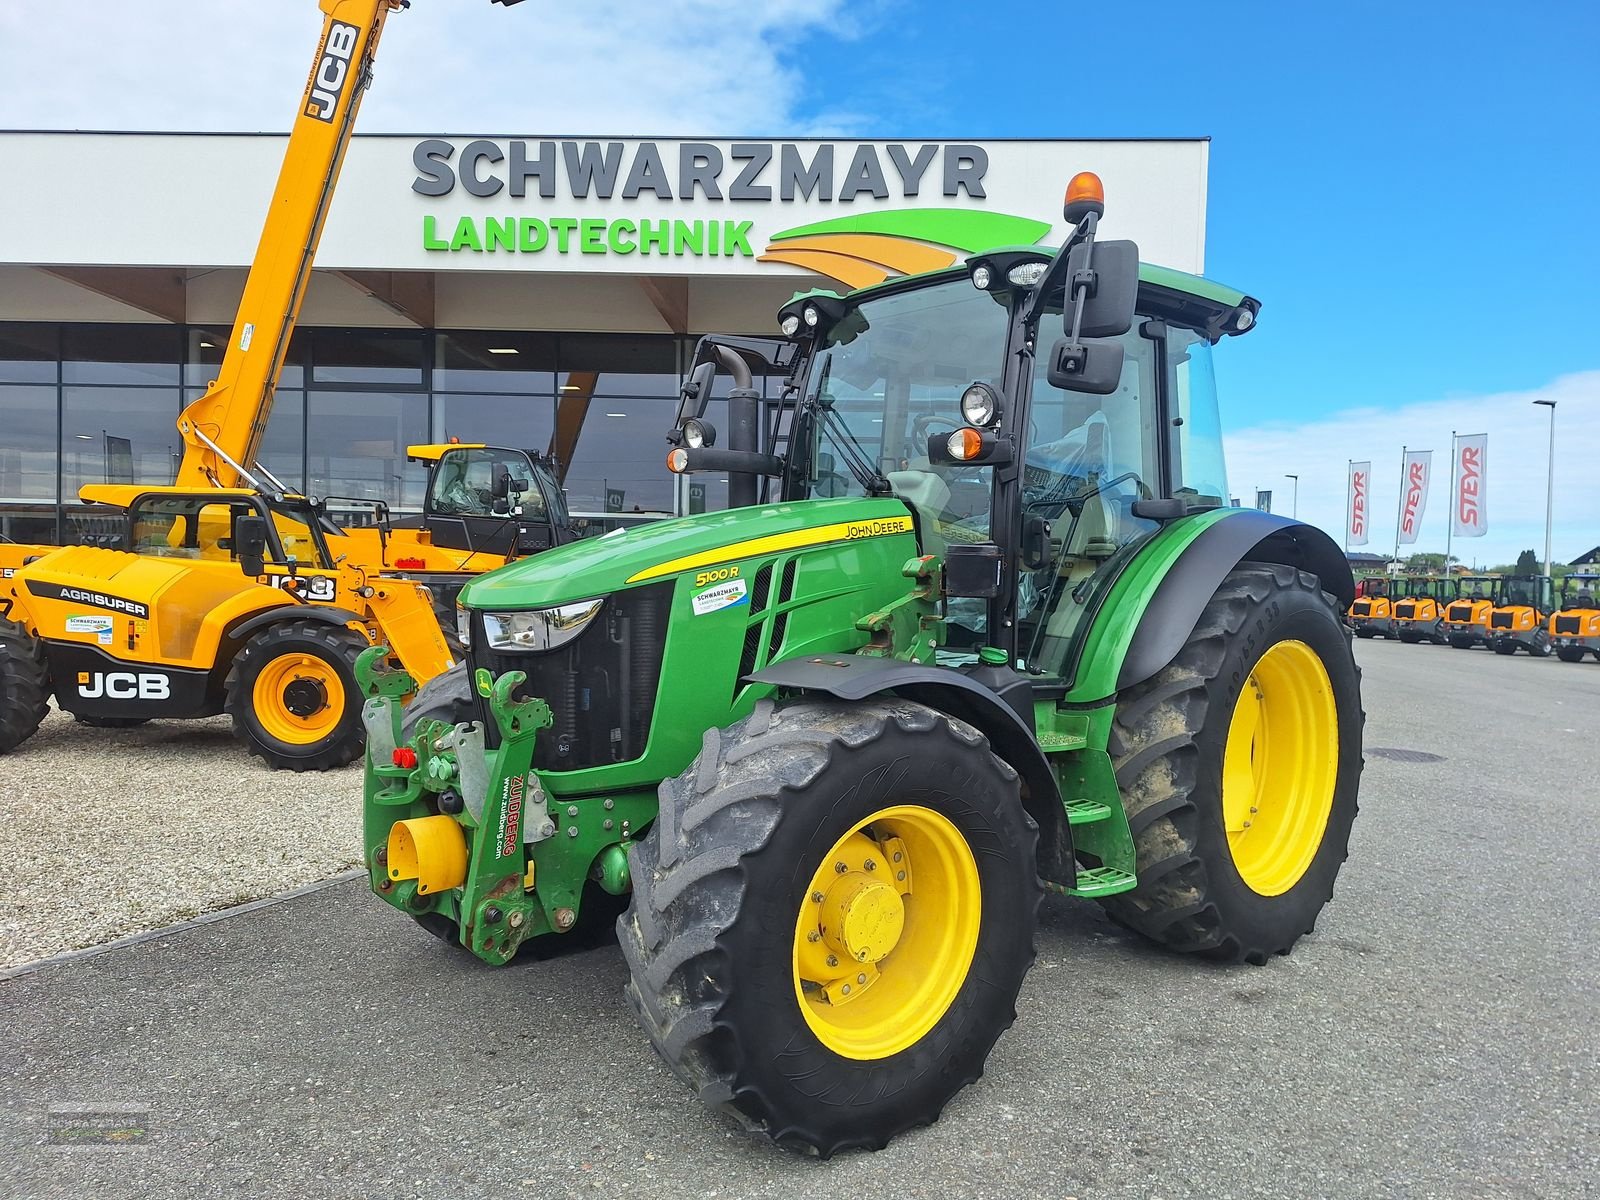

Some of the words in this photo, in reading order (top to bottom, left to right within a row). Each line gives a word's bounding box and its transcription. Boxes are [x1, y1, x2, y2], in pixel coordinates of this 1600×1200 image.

[304, 34, 325, 95] www.schwarzmayr.at
[312, 23, 357, 119] JCB
[411, 139, 989, 202] SCHWARZMAYR
[423, 215, 754, 257] LANDTECHNIK
[1352, 471, 1365, 537] STEYR
[1403, 462, 1423, 535] STEYR
[1460, 446, 1479, 527] STEYR
[845, 525, 873, 538] JOHN
[873, 521, 905, 534] DEERE
[60, 588, 146, 616] AGRISUPER
[696, 568, 729, 587] 5100
[730, 566, 739, 578] R
[696, 586, 740, 602] SCHWARZMAYR
[78, 672, 170, 699] JCB
[495, 776, 510, 860] www.zuidberg.com
[502, 773, 524, 857] ZUIDBERG
